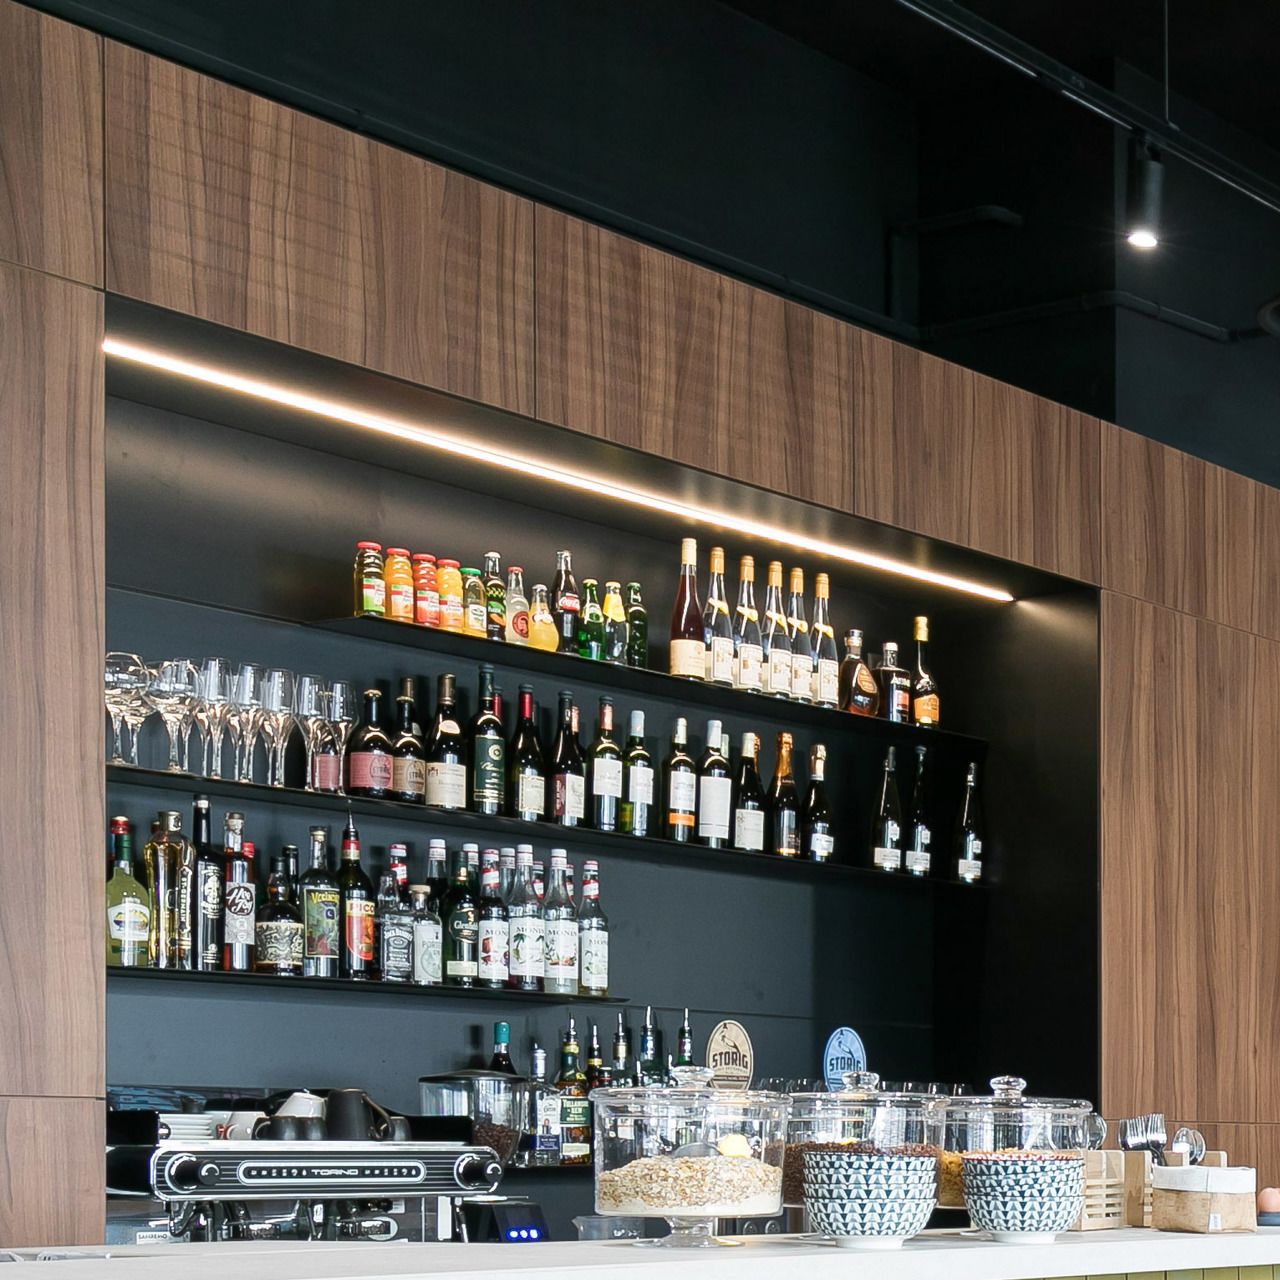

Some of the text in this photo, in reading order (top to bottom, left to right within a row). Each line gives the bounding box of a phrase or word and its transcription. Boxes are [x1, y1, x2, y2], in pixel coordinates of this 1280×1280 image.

[712, 1051, 748, 1069] STORIG
[829, 1057, 862, 1072] STORIG
[311, 1168, 359, 1176] TORINO
